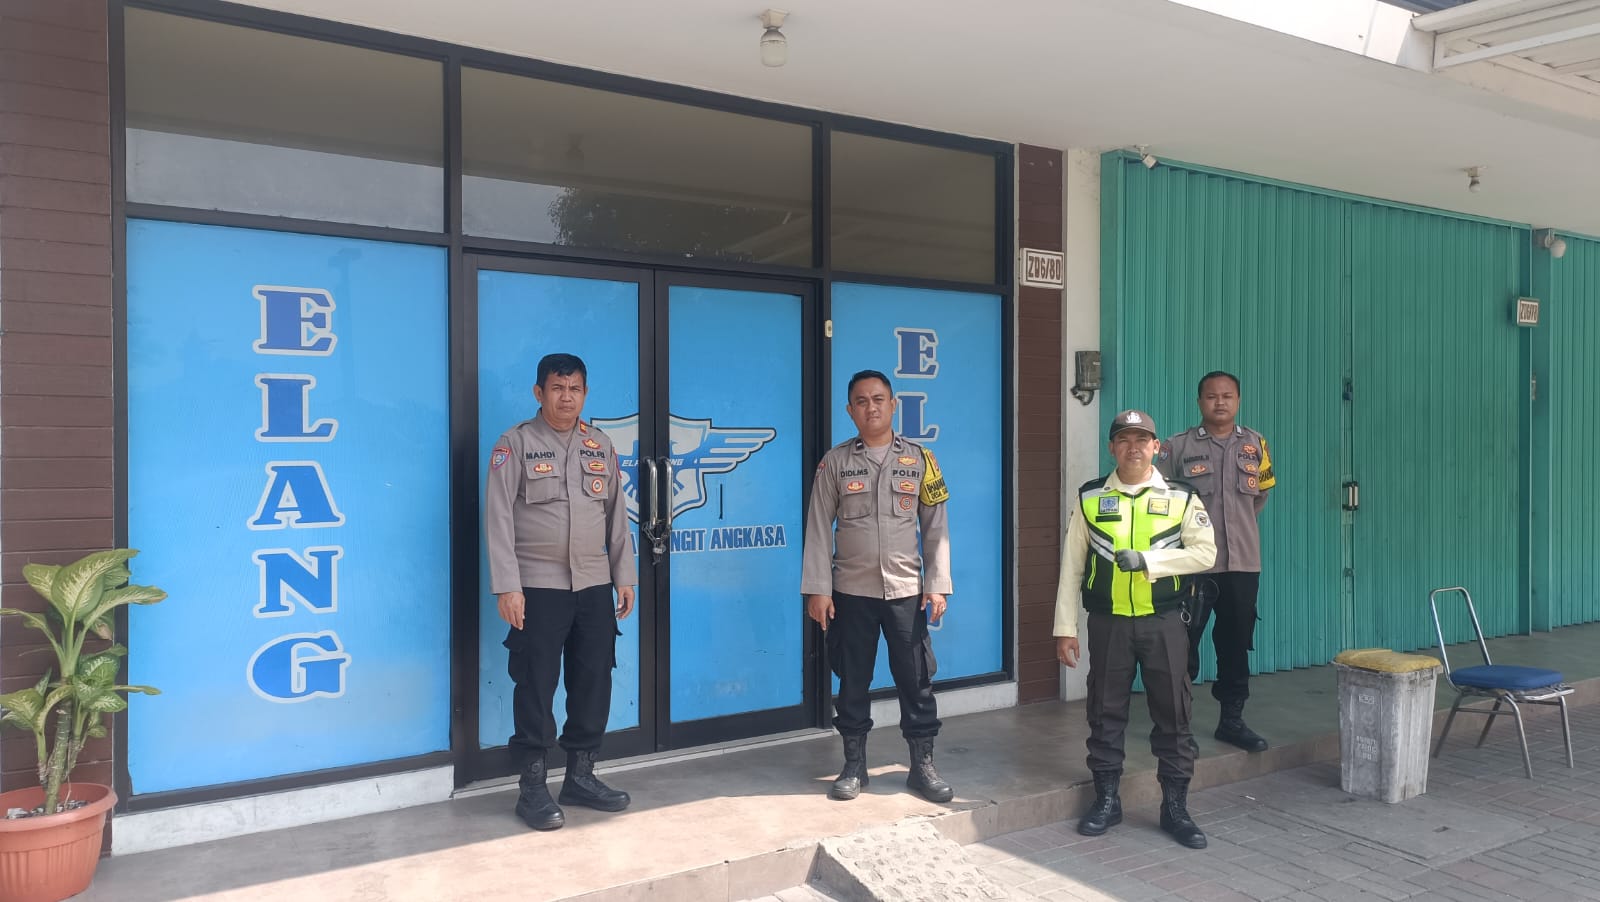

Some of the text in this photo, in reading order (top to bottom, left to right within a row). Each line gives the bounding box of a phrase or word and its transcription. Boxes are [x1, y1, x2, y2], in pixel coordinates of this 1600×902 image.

[525, 450, 556, 460] MAHDI
[580, 449, 606, 459] POLRI
[892, 469, 920, 479] POLRI
[248, 285, 351, 702] ELANG
[670, 525, 786, 552] NGIT ANGKASA
